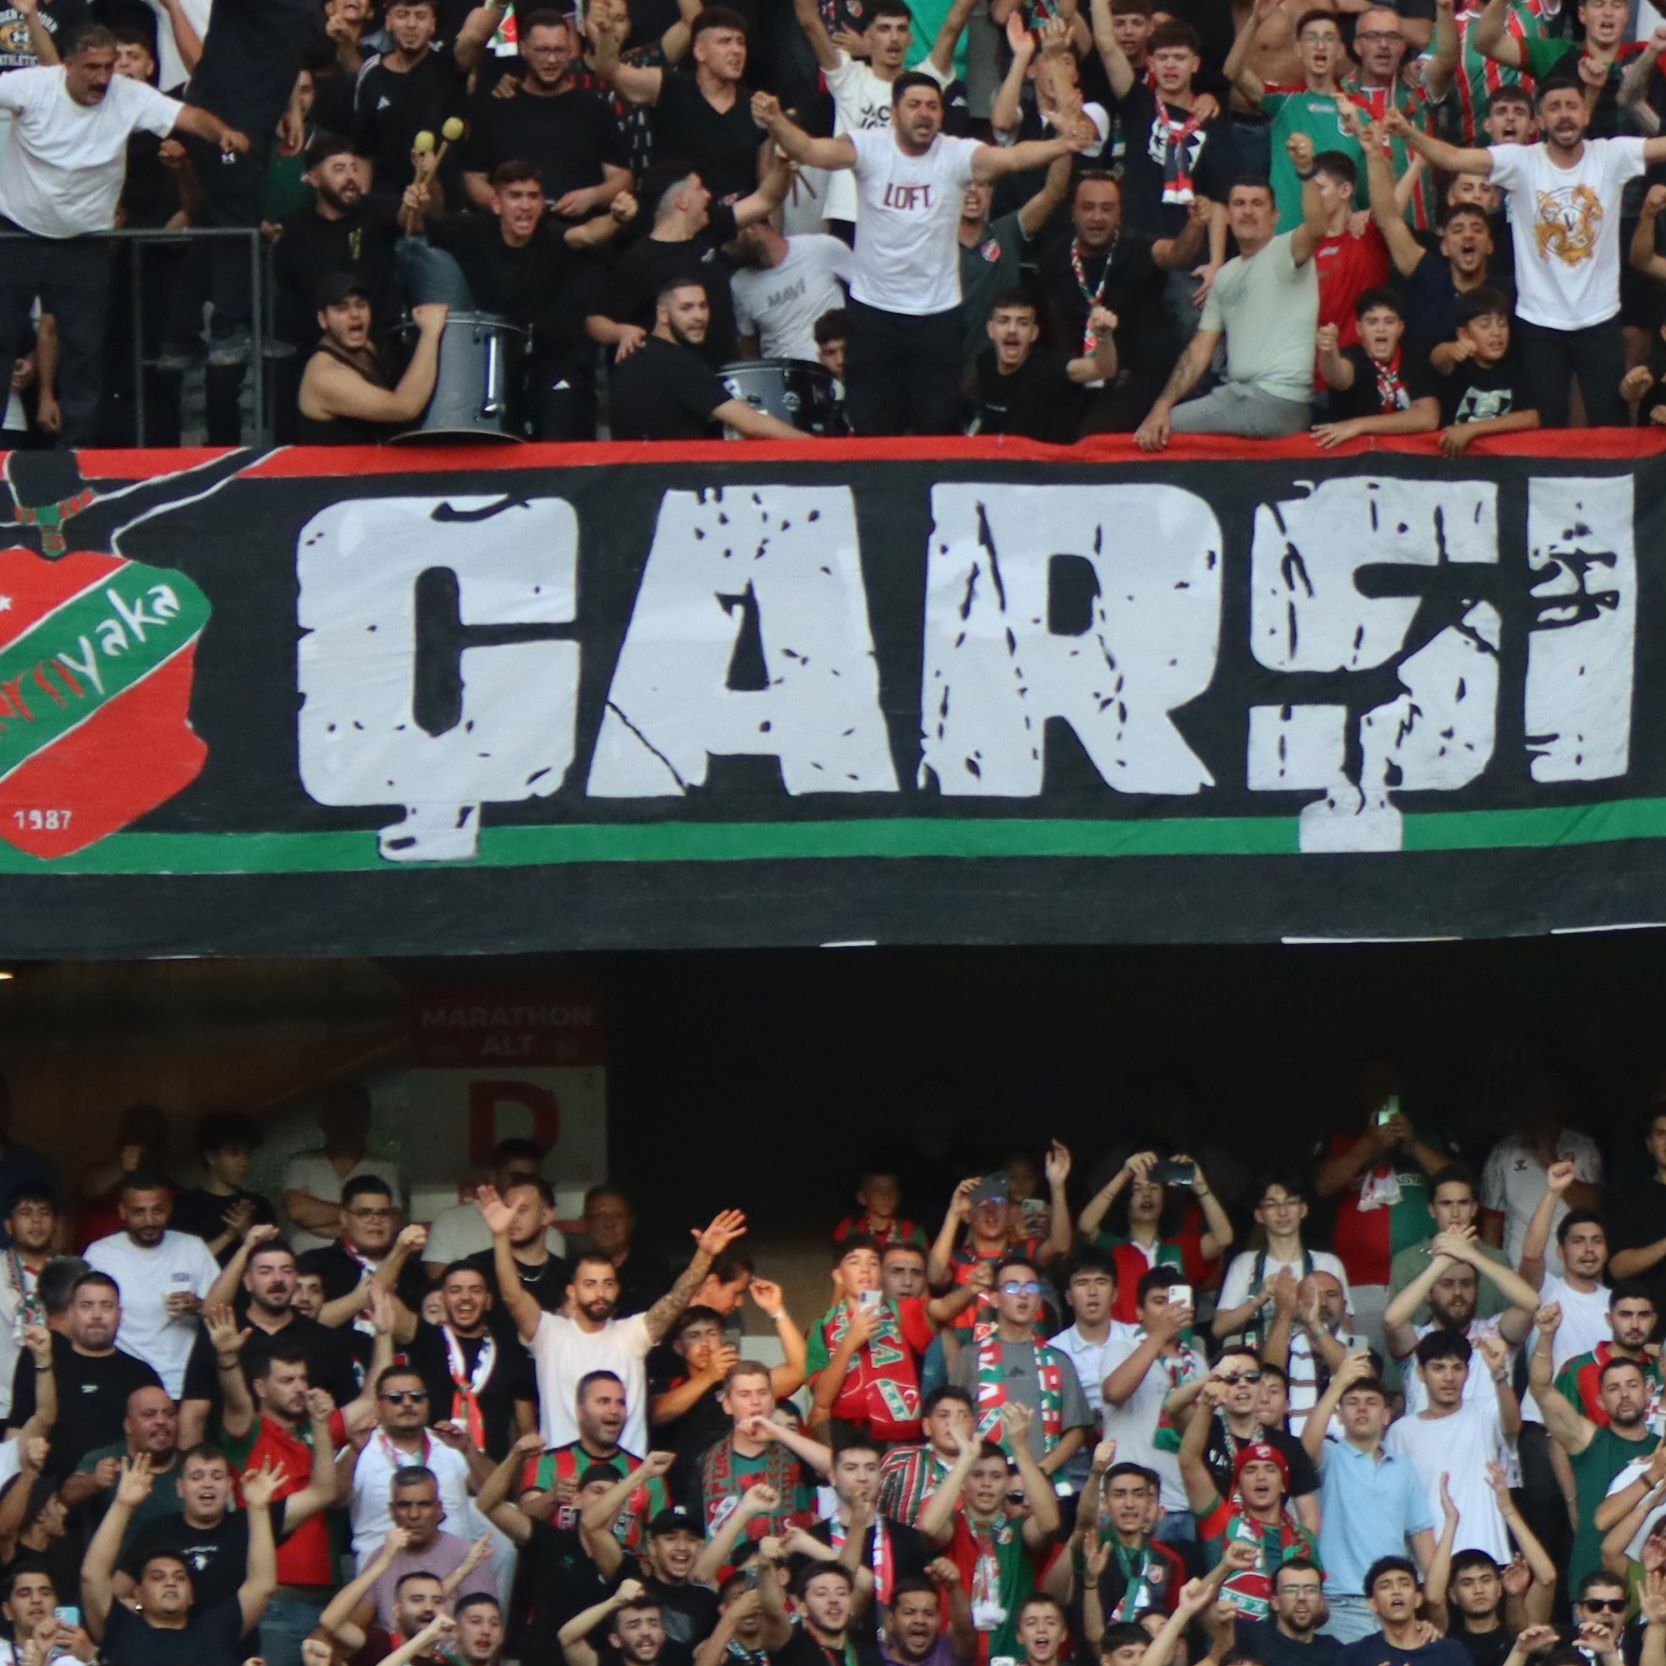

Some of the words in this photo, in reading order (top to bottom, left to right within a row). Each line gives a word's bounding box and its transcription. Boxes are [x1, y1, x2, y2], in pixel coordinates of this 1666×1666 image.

[883, 181, 933, 212] LOFT
[298, 474, 1636, 862] ÇARŞI
[13, 809, 73, 830] 1987
[422, 1005, 593, 1027] MARATHON
[481, 1034, 535, 1057] ALT
